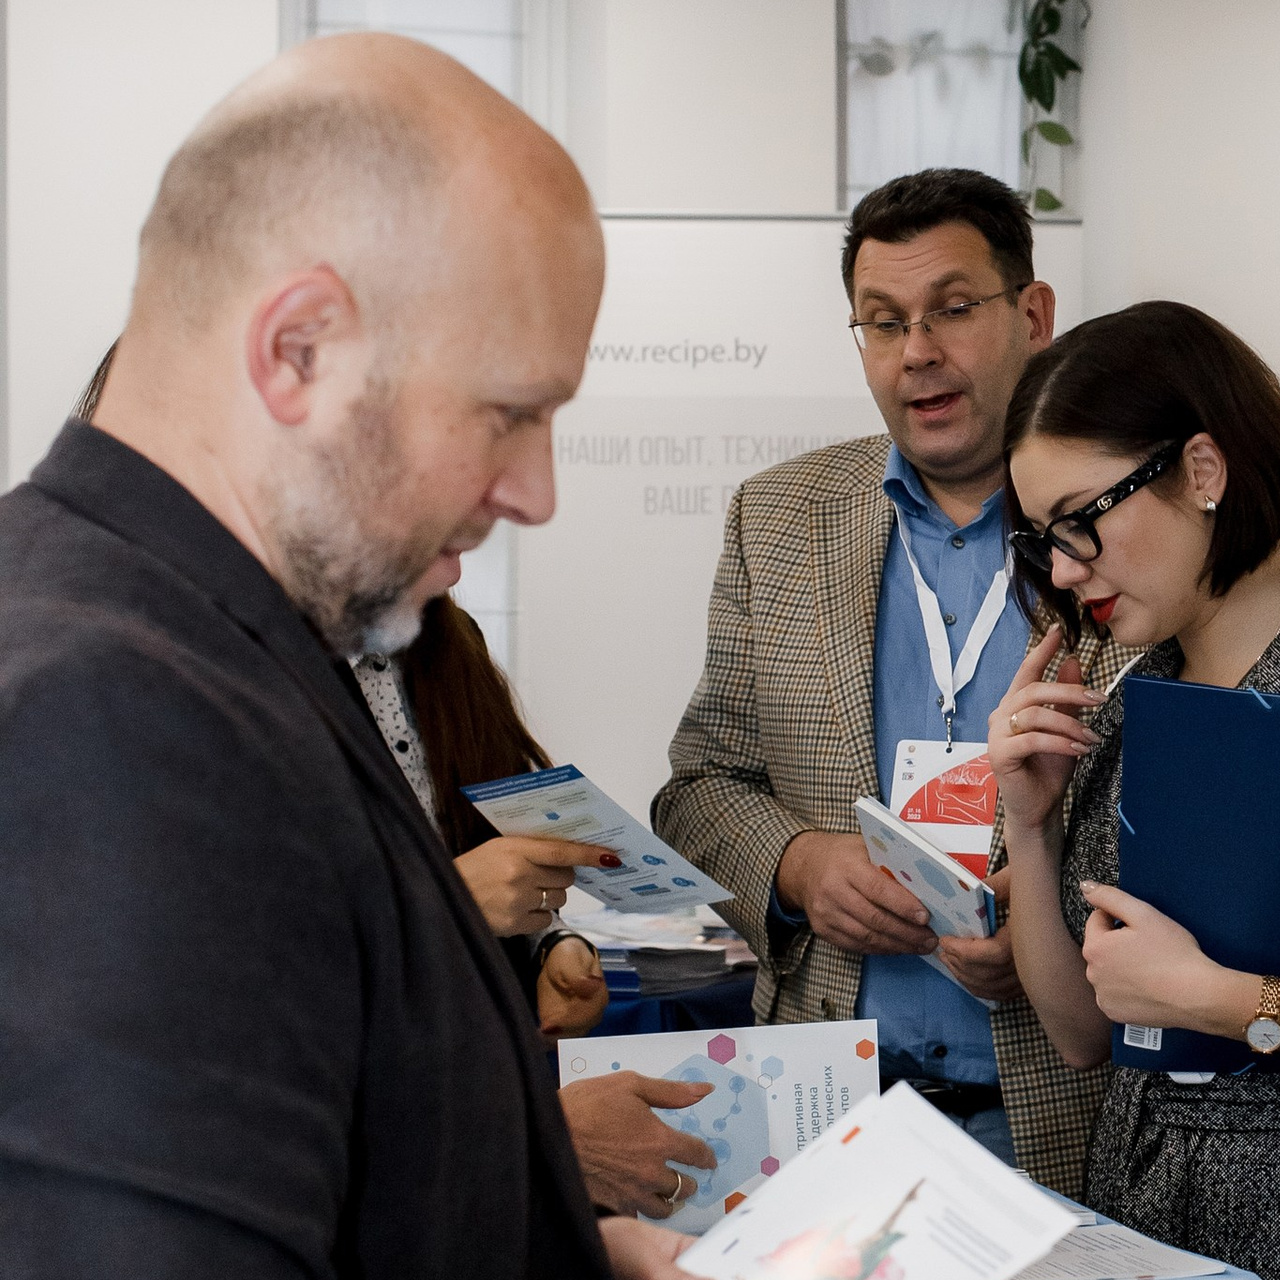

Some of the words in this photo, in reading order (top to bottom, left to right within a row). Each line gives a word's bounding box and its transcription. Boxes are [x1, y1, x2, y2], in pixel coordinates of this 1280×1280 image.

[558, 435, 631, 467] НАШИ
[643, 485, 713, 515] ВАШЕ
[794, 1083, 807, 1151] тритивная
